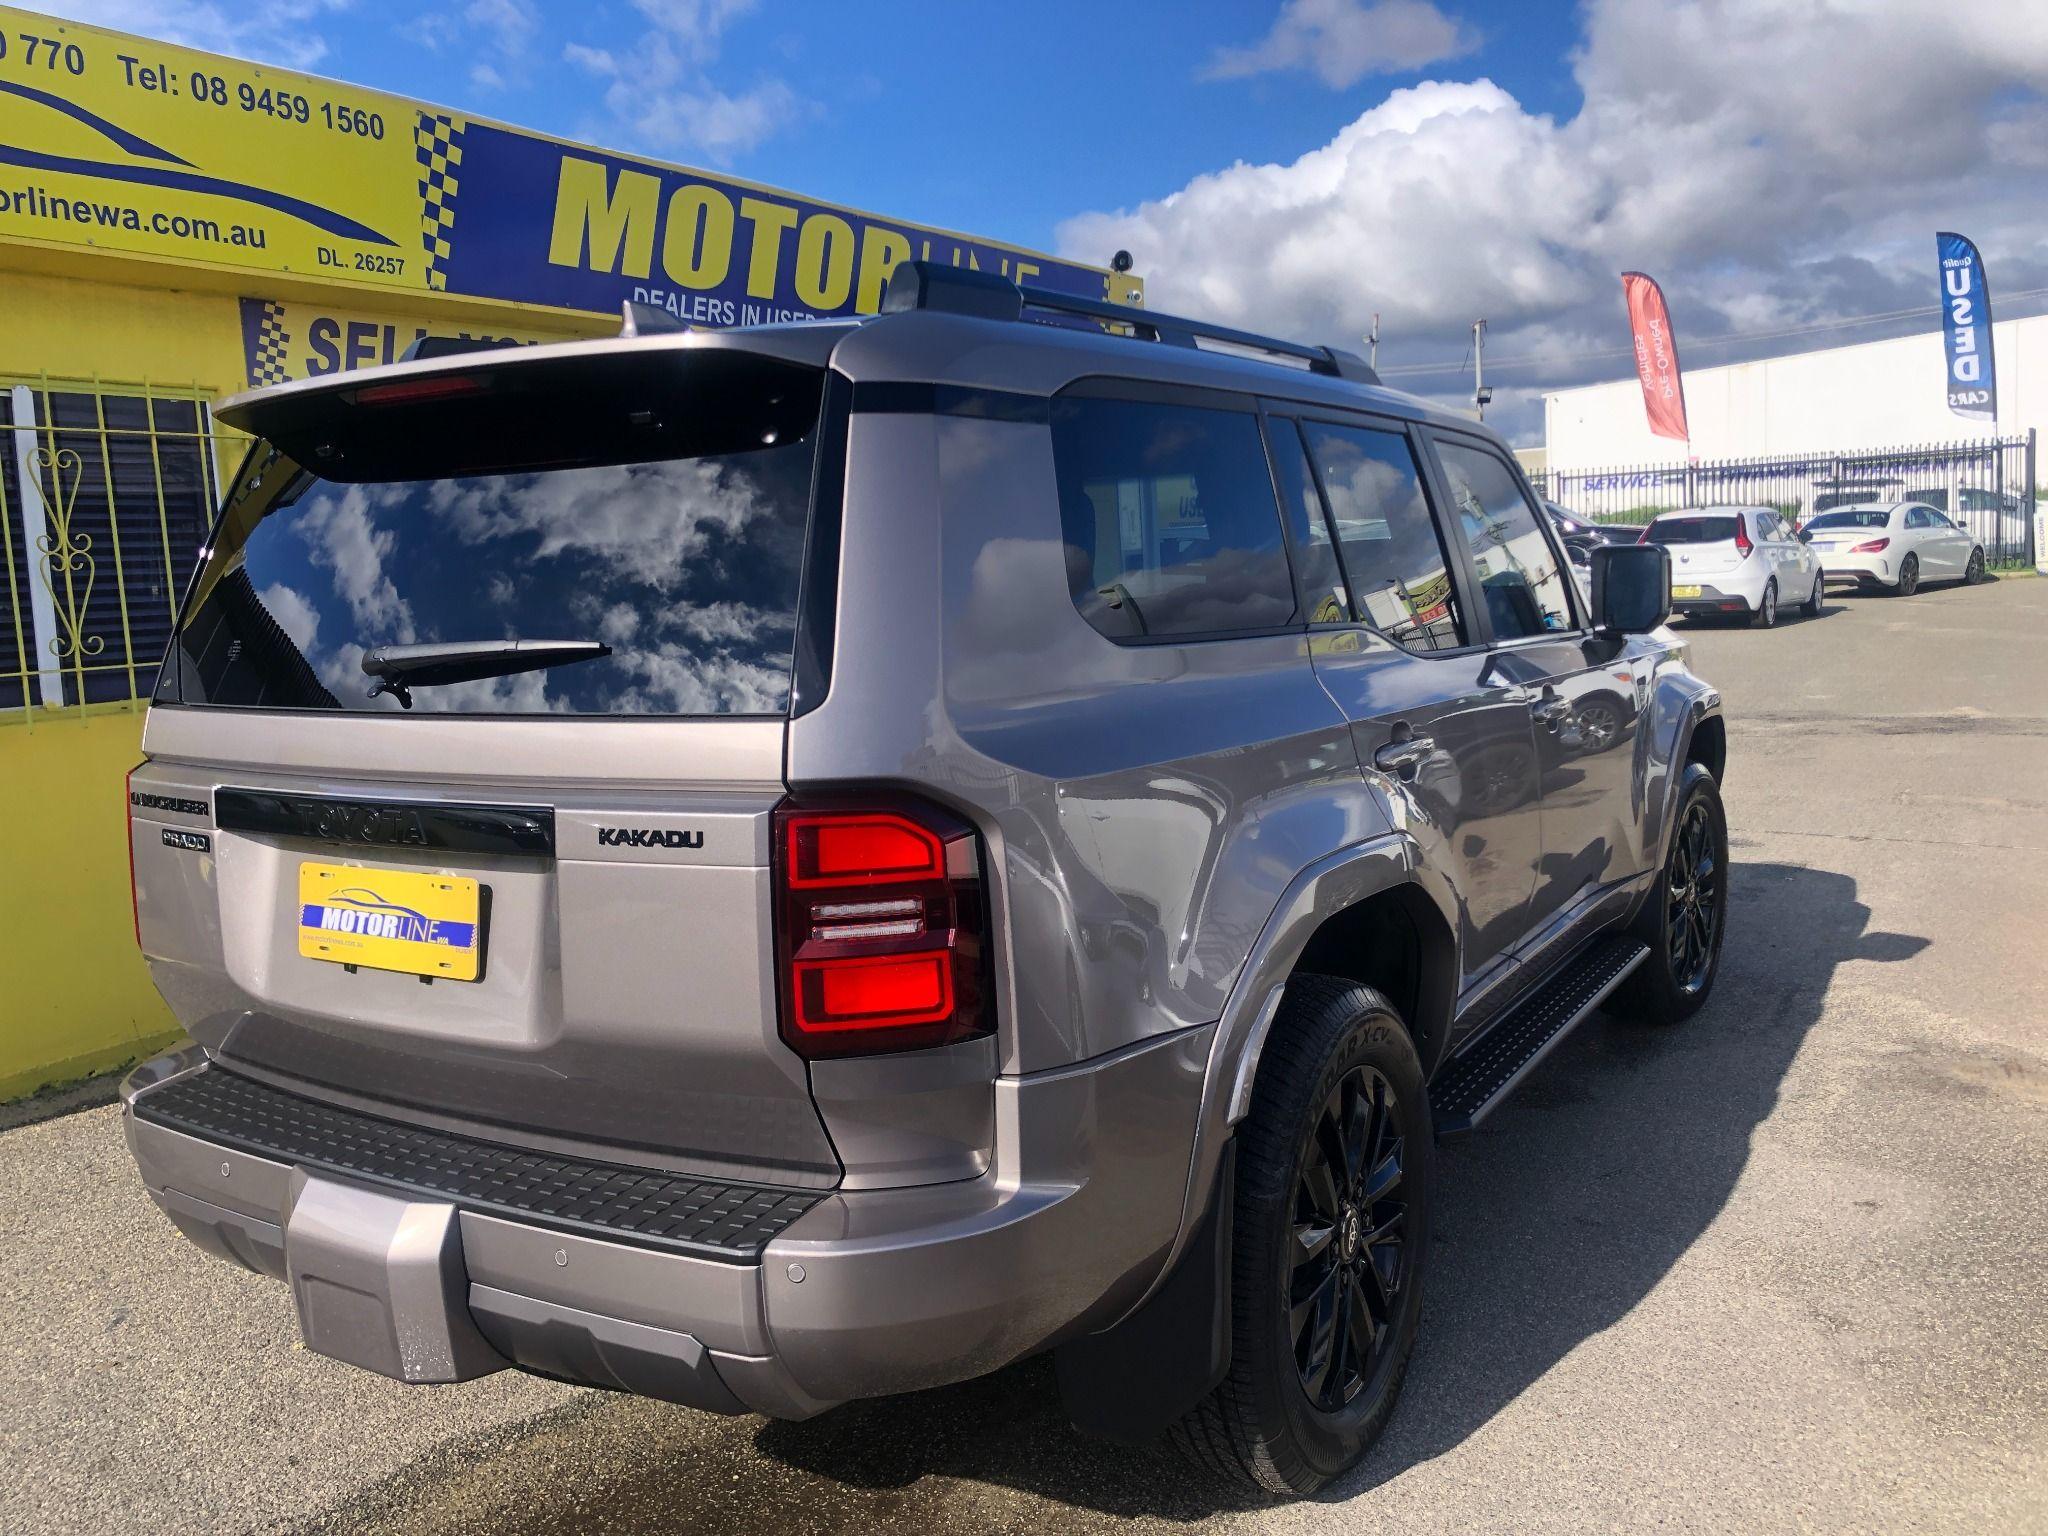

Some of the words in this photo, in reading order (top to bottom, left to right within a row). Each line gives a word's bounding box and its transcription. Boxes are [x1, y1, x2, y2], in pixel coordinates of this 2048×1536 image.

[20, 33, 84, 75] 770
[116, 54, 178, 96] Tel:
[190, 72, 228, 106] 08
[238, 82, 310, 124] 9459
[320, 102, 384, 140] 1560
[548, 155, 1040, 315] MOTOR
[317, 247, 349, 268] DL.
[354, 252, 405, 275] 26257
[634, 286, 736, 326] DEALERS
[741, 303, 761, 327] IN
[1582, 474, 1663, 492] SERVICE
[2038, 516, 2047, 558] WELCOME
[162, 829, 210, 853] PRADO
[297, 802, 428, 845] TOYOTA
[598, 827, 704, 849] KAKADU
[320, 906, 441, 945] MOTORLINE
